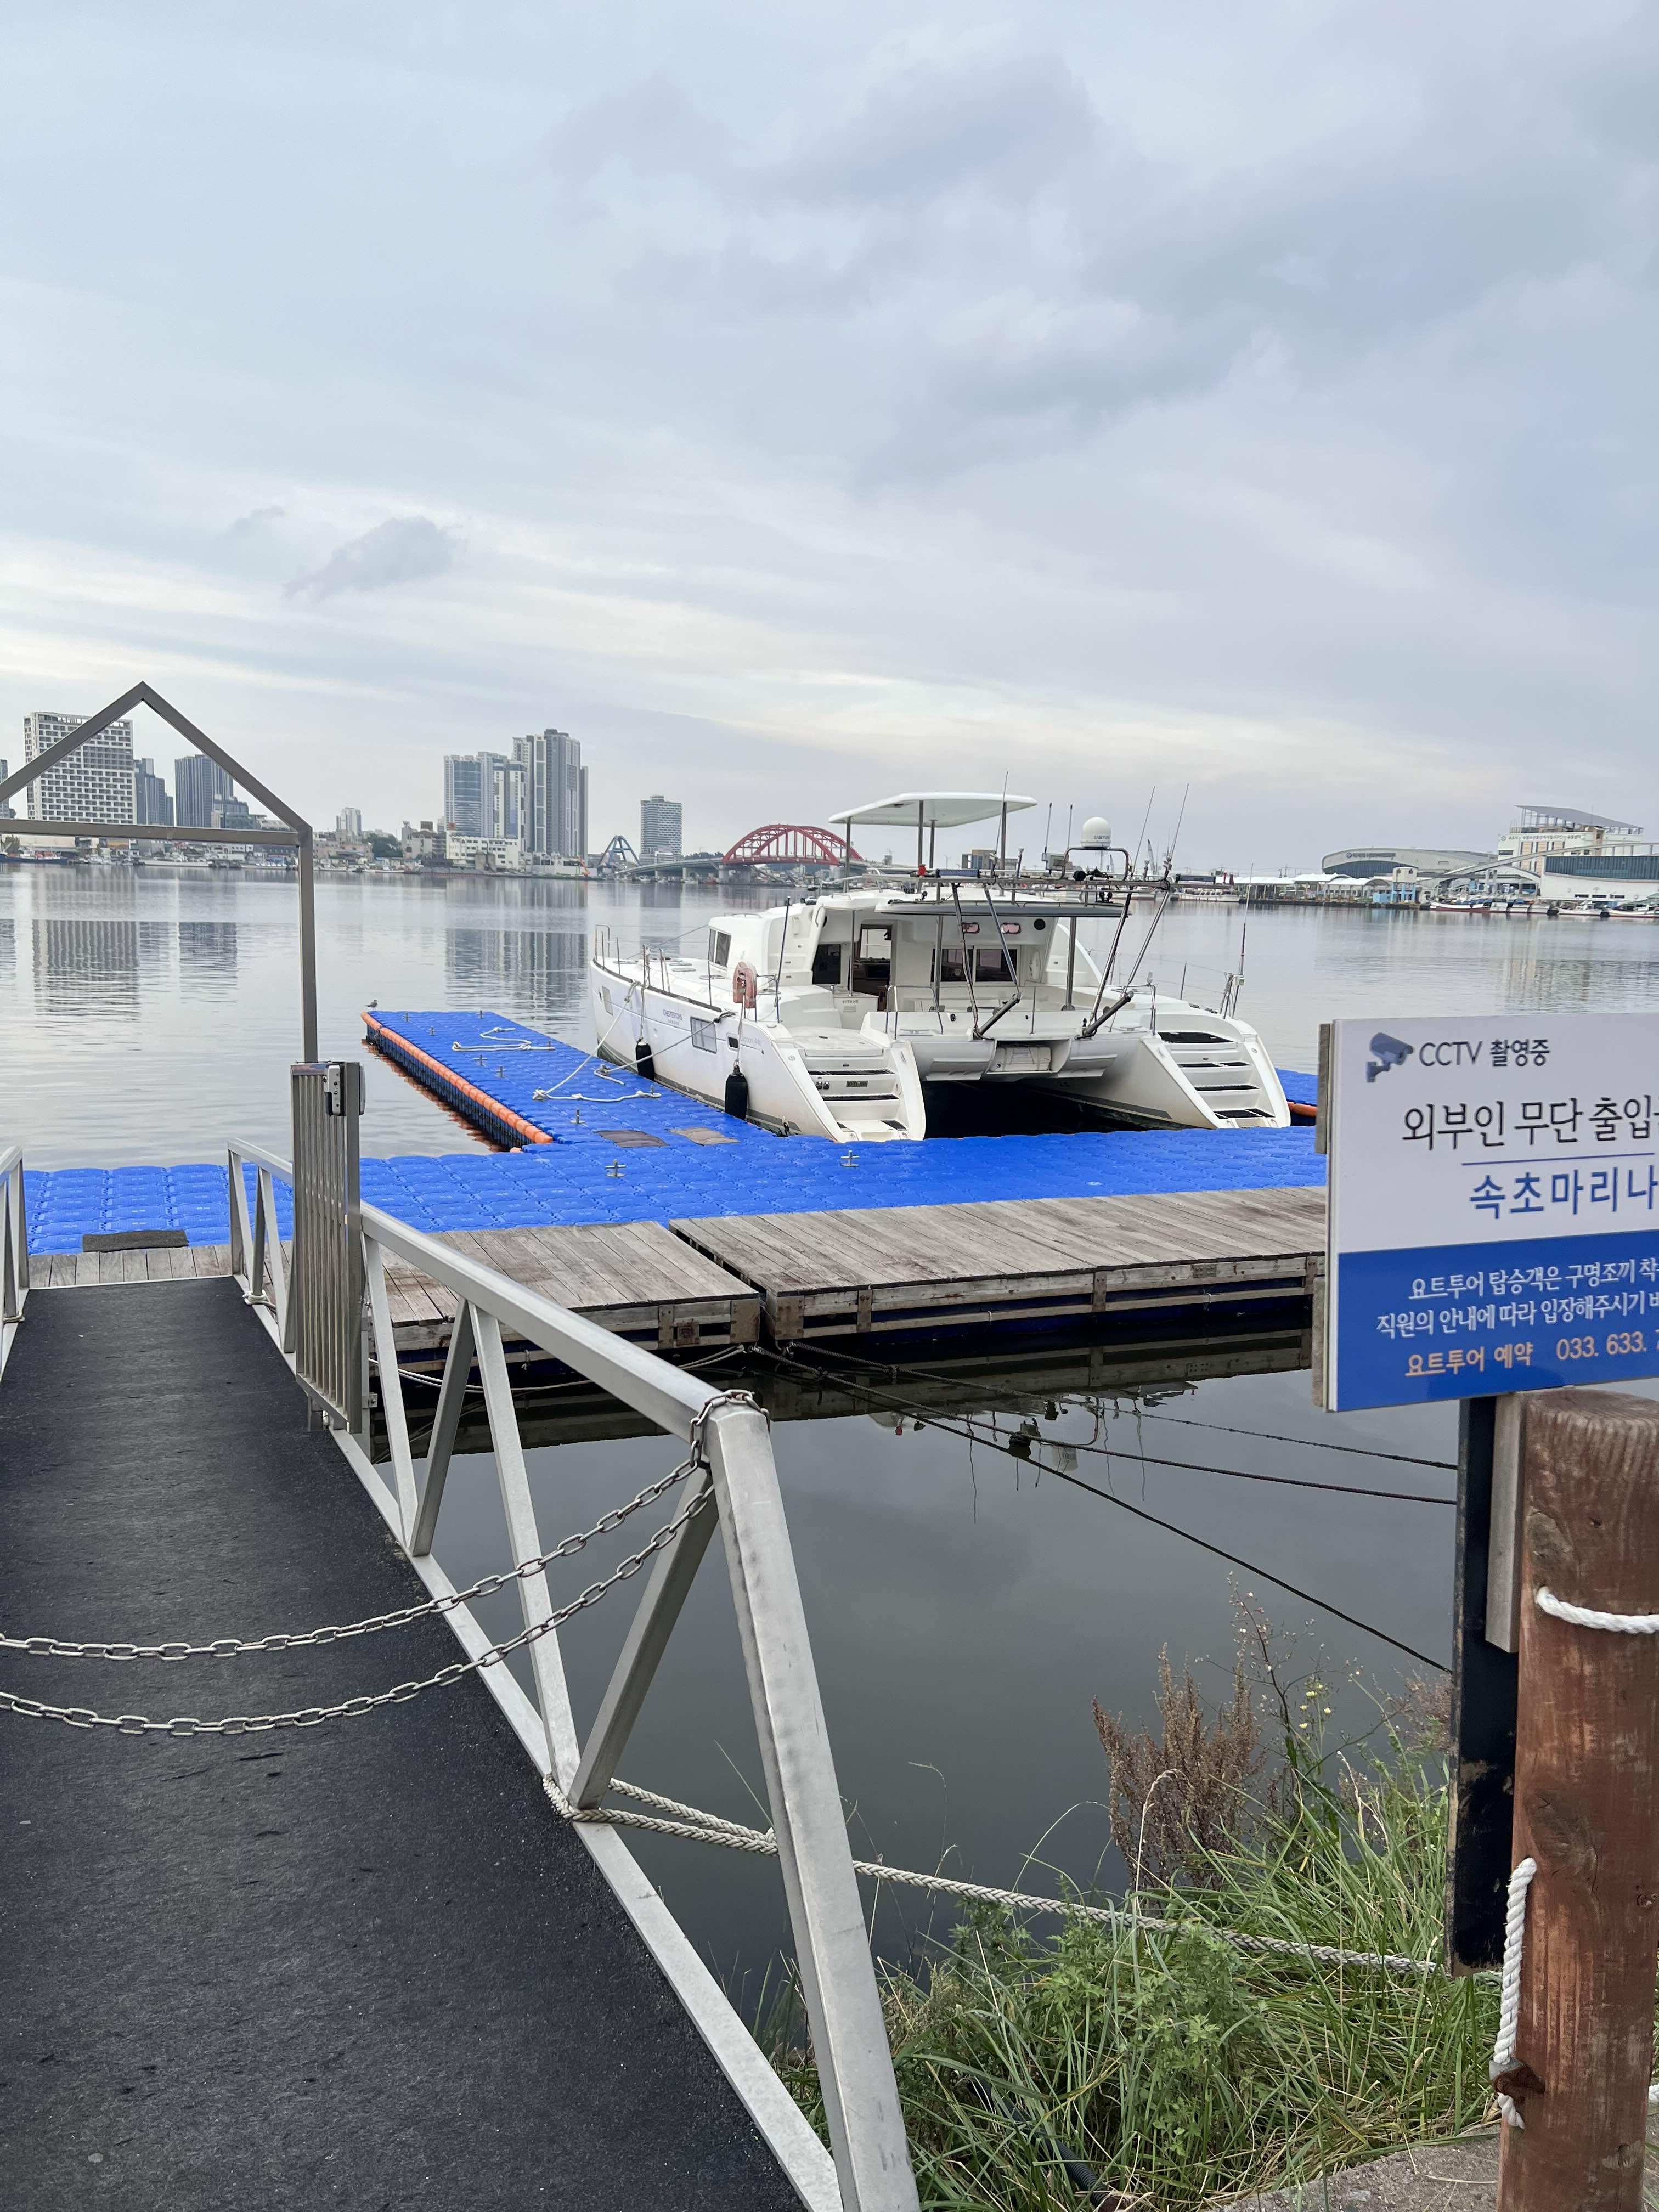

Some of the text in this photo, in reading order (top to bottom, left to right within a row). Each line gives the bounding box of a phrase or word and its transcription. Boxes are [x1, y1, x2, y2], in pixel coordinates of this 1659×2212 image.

[1419, 1039, 1550, 1067] CCTV 촬영중
[1401, 1101, 1505, 1151] 외부인
[1588, 1094, 1659, 1142] 출입
[1408, 1257, 1659, 1300] 요트투어 탑승객은 구명조끼 착
[1376, 1310, 1435, 1340] 직원의
[1439, 1304, 1496, 1334] 안내에
[1499, 1300, 1538, 1328] 따라
[1540, 1290, 1645, 1324] 입장해주시기
[1404, 1346, 1485, 1377] 요트투어
[1493, 1342, 1534, 1369] 예약
[1556, 1335, 1599, 1361] 033.
[1605, 1330, 1647, 1356] 633.
